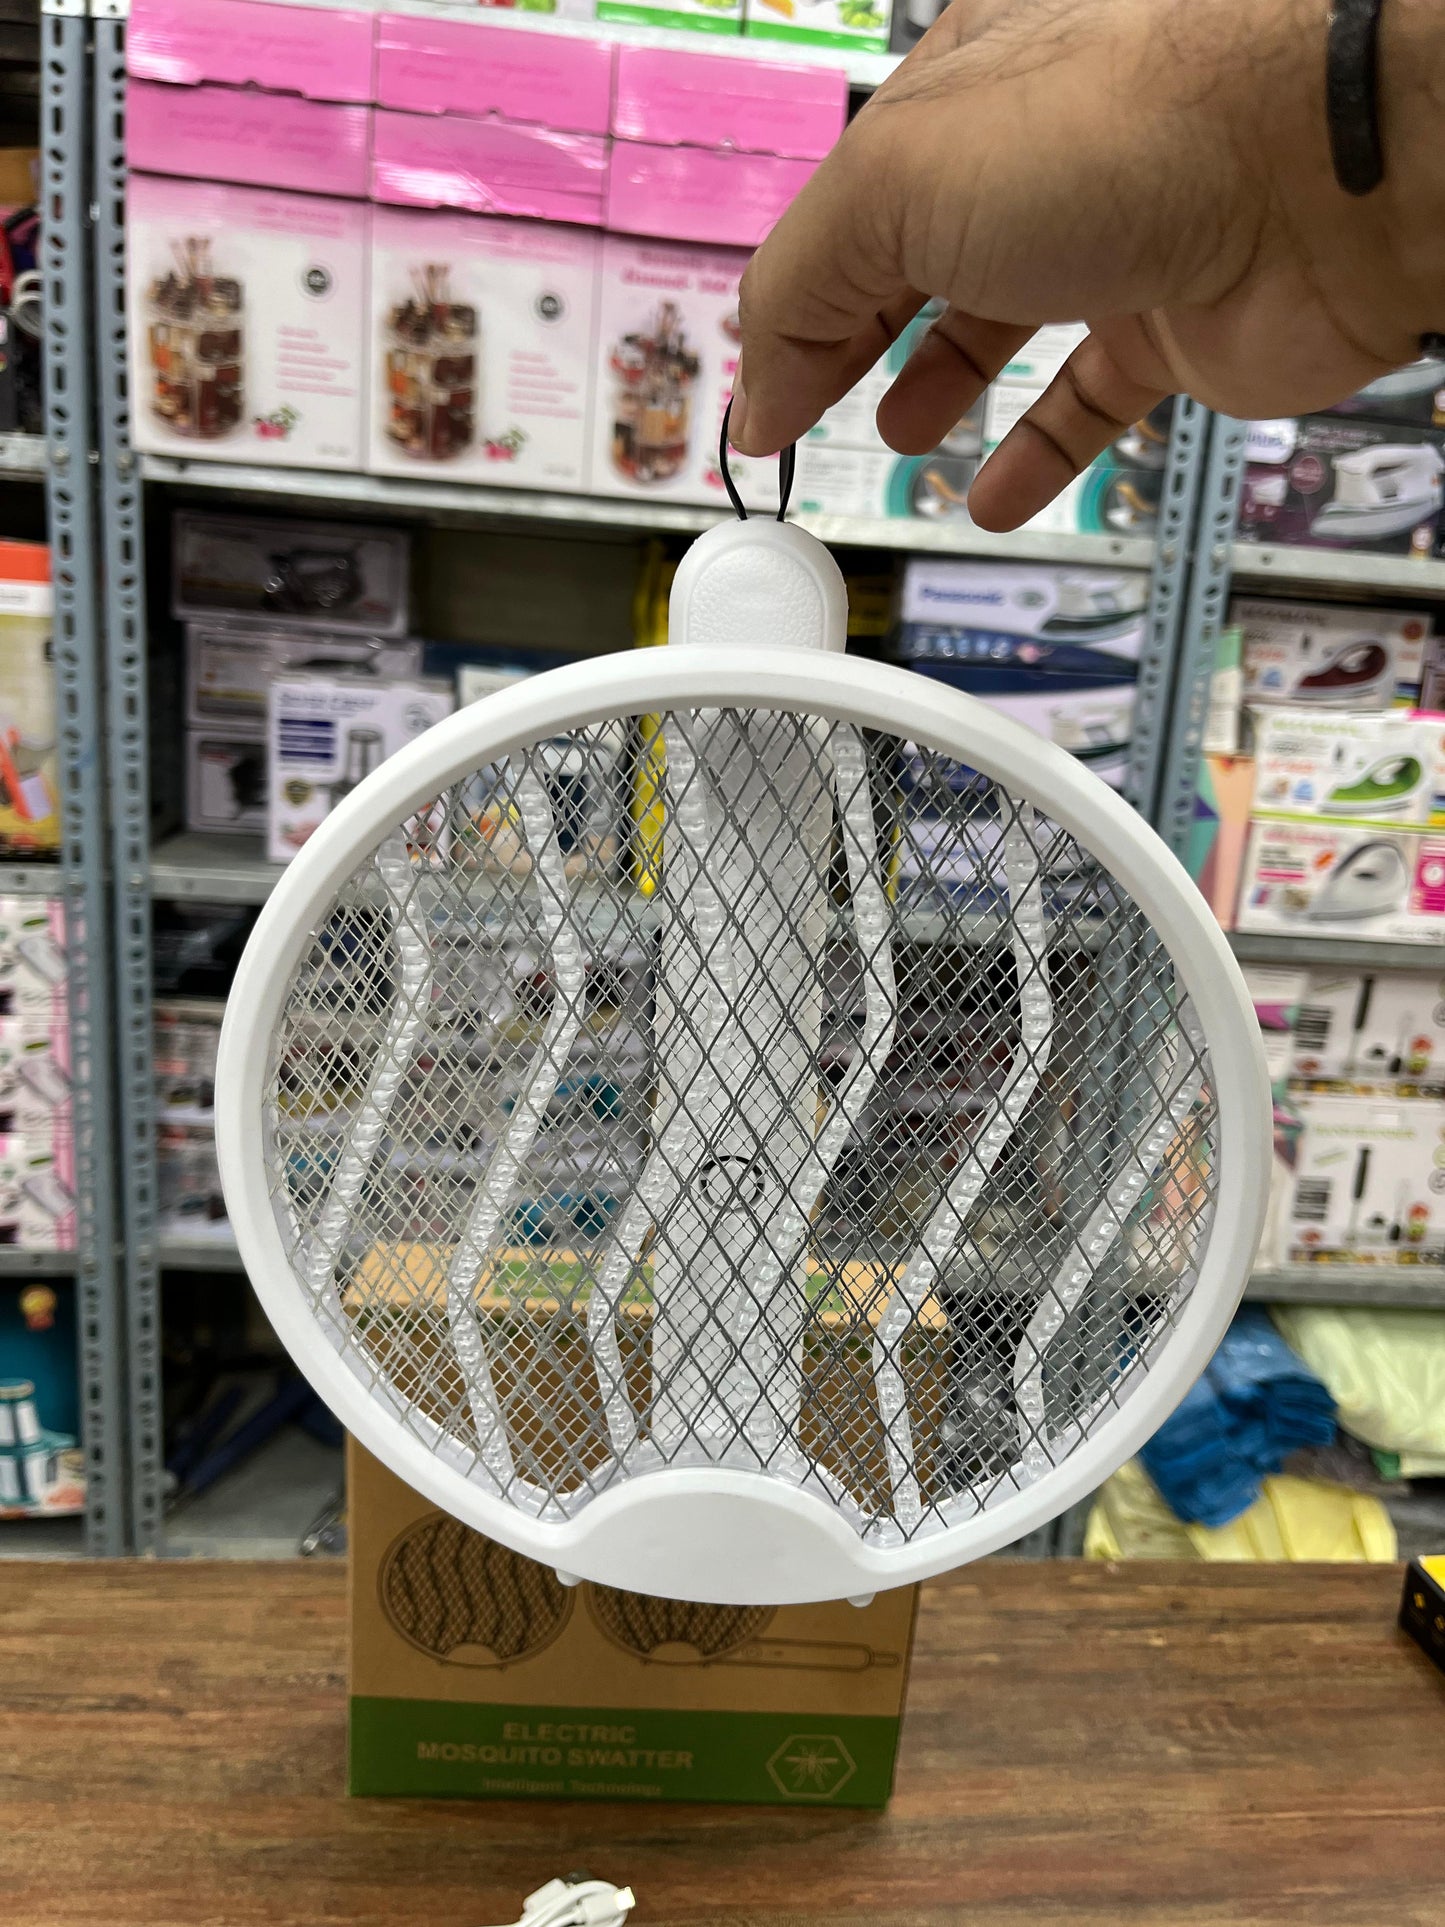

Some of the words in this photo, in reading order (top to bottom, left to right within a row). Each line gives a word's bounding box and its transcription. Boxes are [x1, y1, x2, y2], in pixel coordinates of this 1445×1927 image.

[503, 1721, 636, 1743] ELECTRIC
[417, 1741, 561, 1766] MOSQUITO
[567, 1747, 693, 1769] SWATTER
